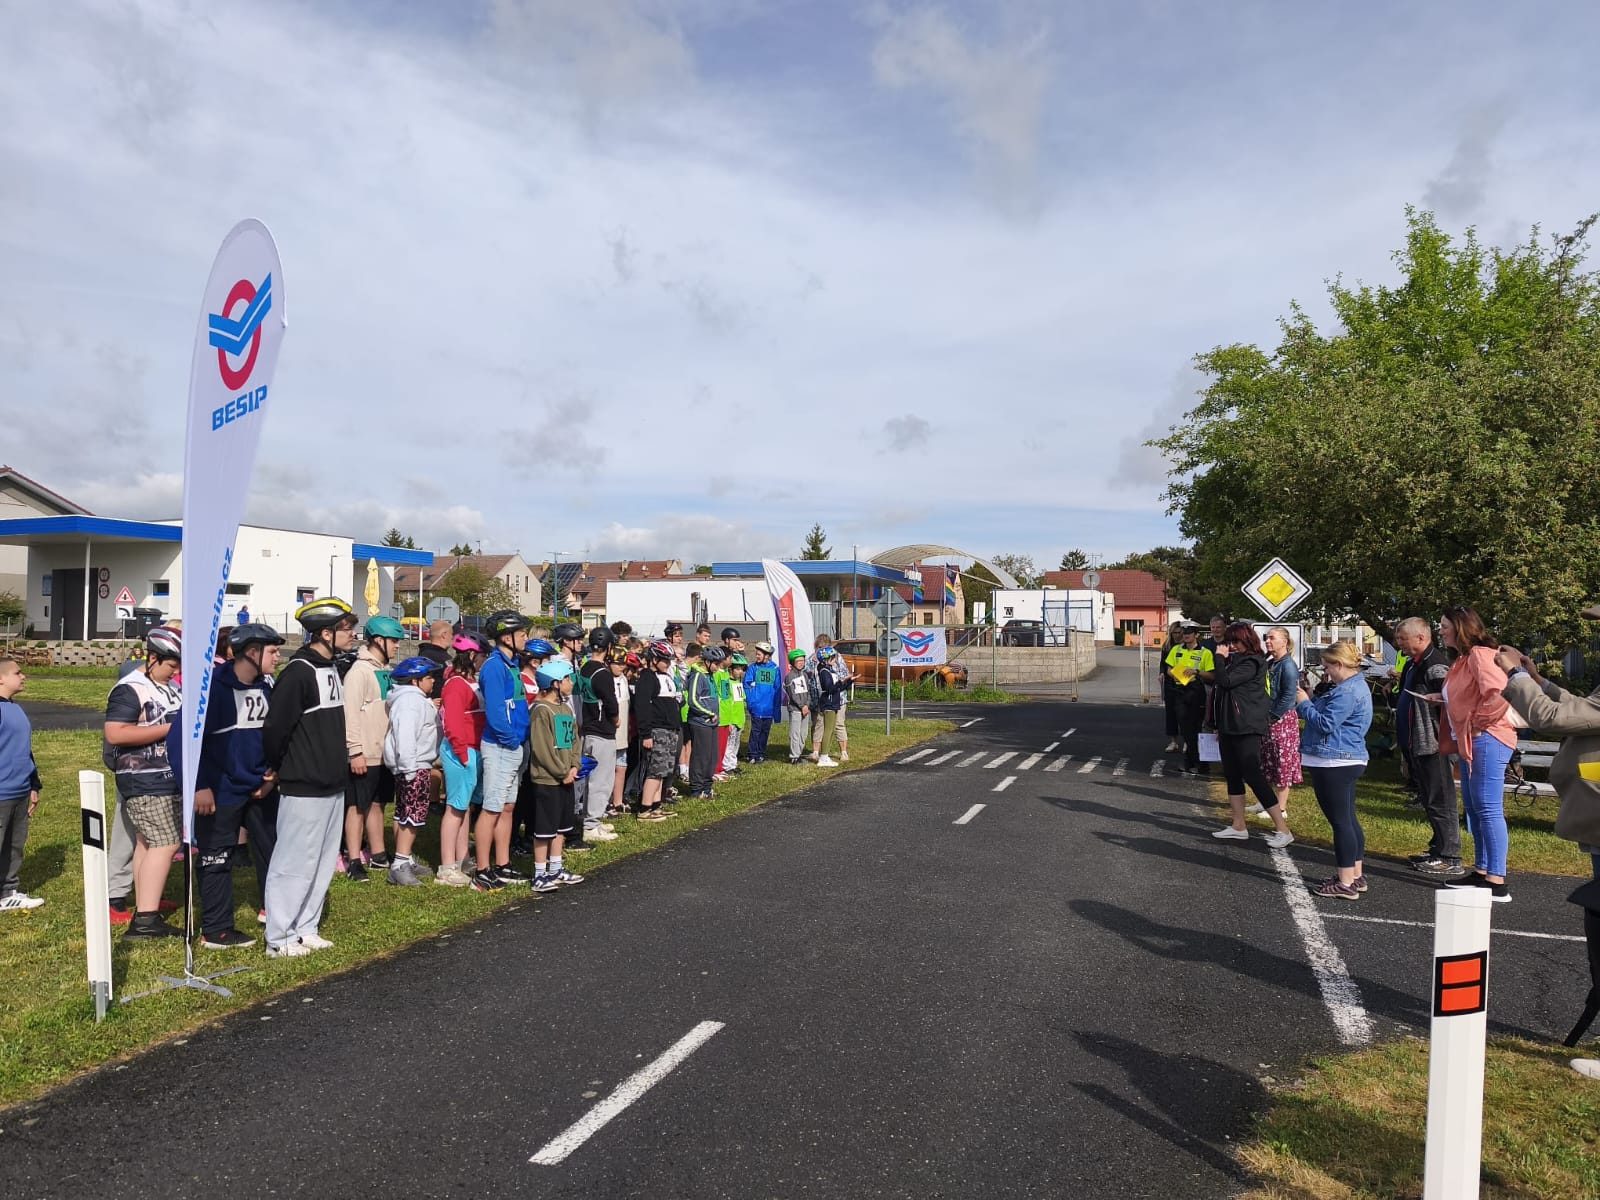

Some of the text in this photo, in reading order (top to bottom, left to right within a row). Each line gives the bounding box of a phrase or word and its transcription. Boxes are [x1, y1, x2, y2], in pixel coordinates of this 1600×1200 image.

[212, 385, 268, 431] BESIP
[193, 547, 232, 738] www.besip.cz
[245, 695, 265, 722] 22
